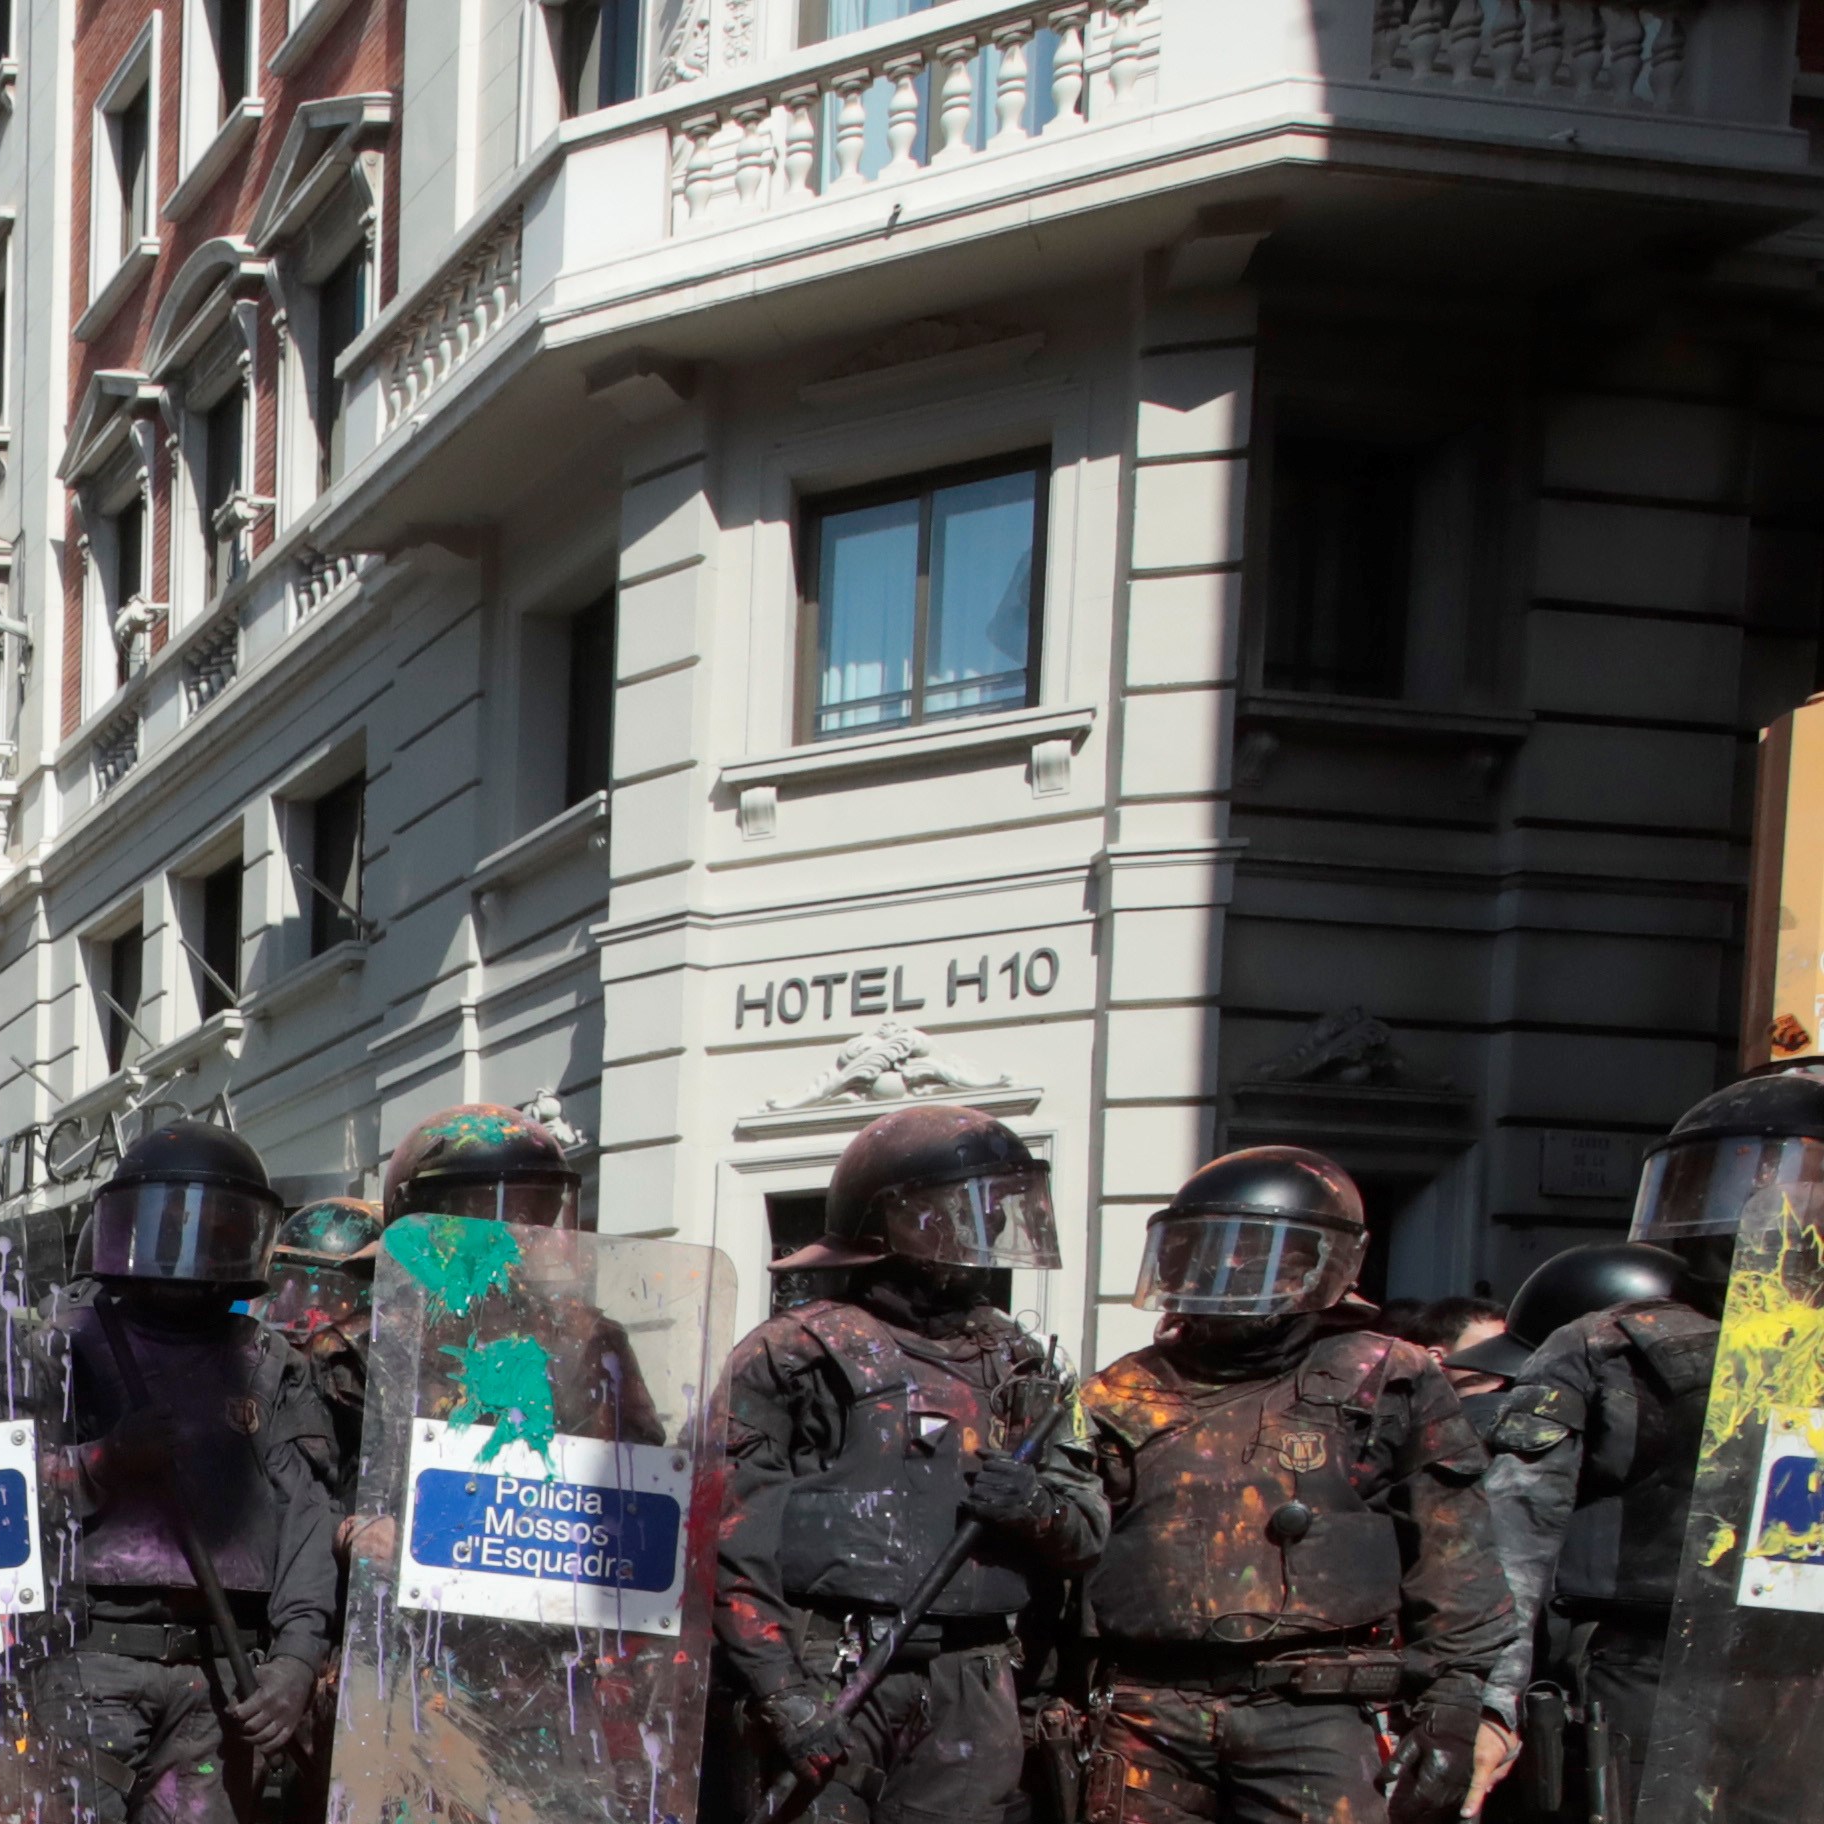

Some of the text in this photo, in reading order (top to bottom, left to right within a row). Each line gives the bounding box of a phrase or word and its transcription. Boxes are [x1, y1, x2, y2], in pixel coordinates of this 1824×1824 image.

[735, 947, 1060, 1030] HOTEL H10
[495, 1476, 603, 1515] Policia
[484, 1506, 609, 1546] Mossos
[452, 1536, 635, 1581] d'Esquadra
